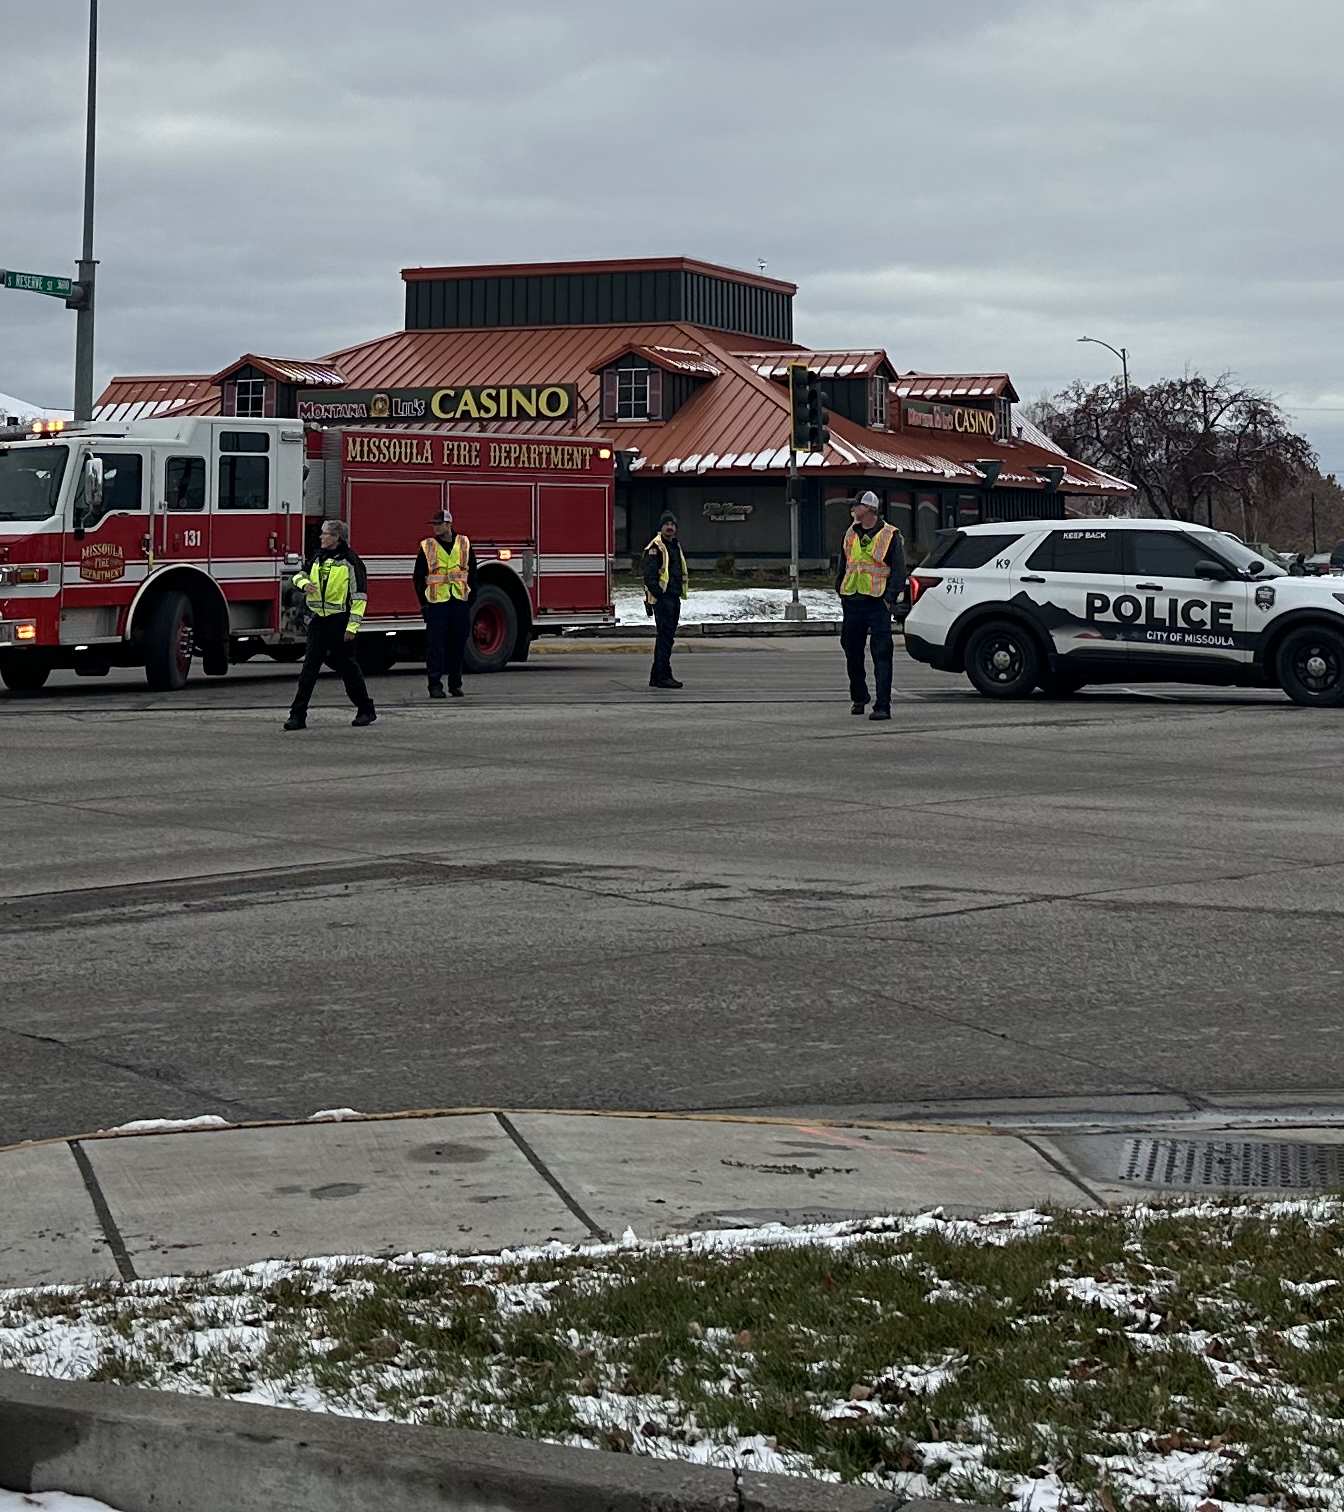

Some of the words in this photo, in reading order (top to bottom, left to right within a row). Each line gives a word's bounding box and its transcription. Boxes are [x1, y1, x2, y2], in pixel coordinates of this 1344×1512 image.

[7, 276, 12, 287] S
[16, 274, 43, 290] RESERVE
[296, 401, 368, 419] MONTANA
[392, 397, 426, 417] LIL'S
[430, 387, 569, 419] CASINO
[954, 408, 996, 436] CASINO
[346, 436, 434, 464] MISSOULA
[442, 440, 481, 466] FIRE
[489, 442, 594, 470] DEPARTMENT
[183, 530, 201, 547] 131
[81, 543, 124, 559] MISSOULA
[94, 557, 110, 569] FIRE
[995, 558, 1011, 569] K9
[81, 566, 124, 580] DEPARTMENT
[946, 584, 965, 595] 911
[1086, 592, 1233, 632] POLICE
[1146, 630, 1168, 641] CITY
[1169, 633, 1183, 642] OF
[1185, 633, 1235, 647] MISSOULA
